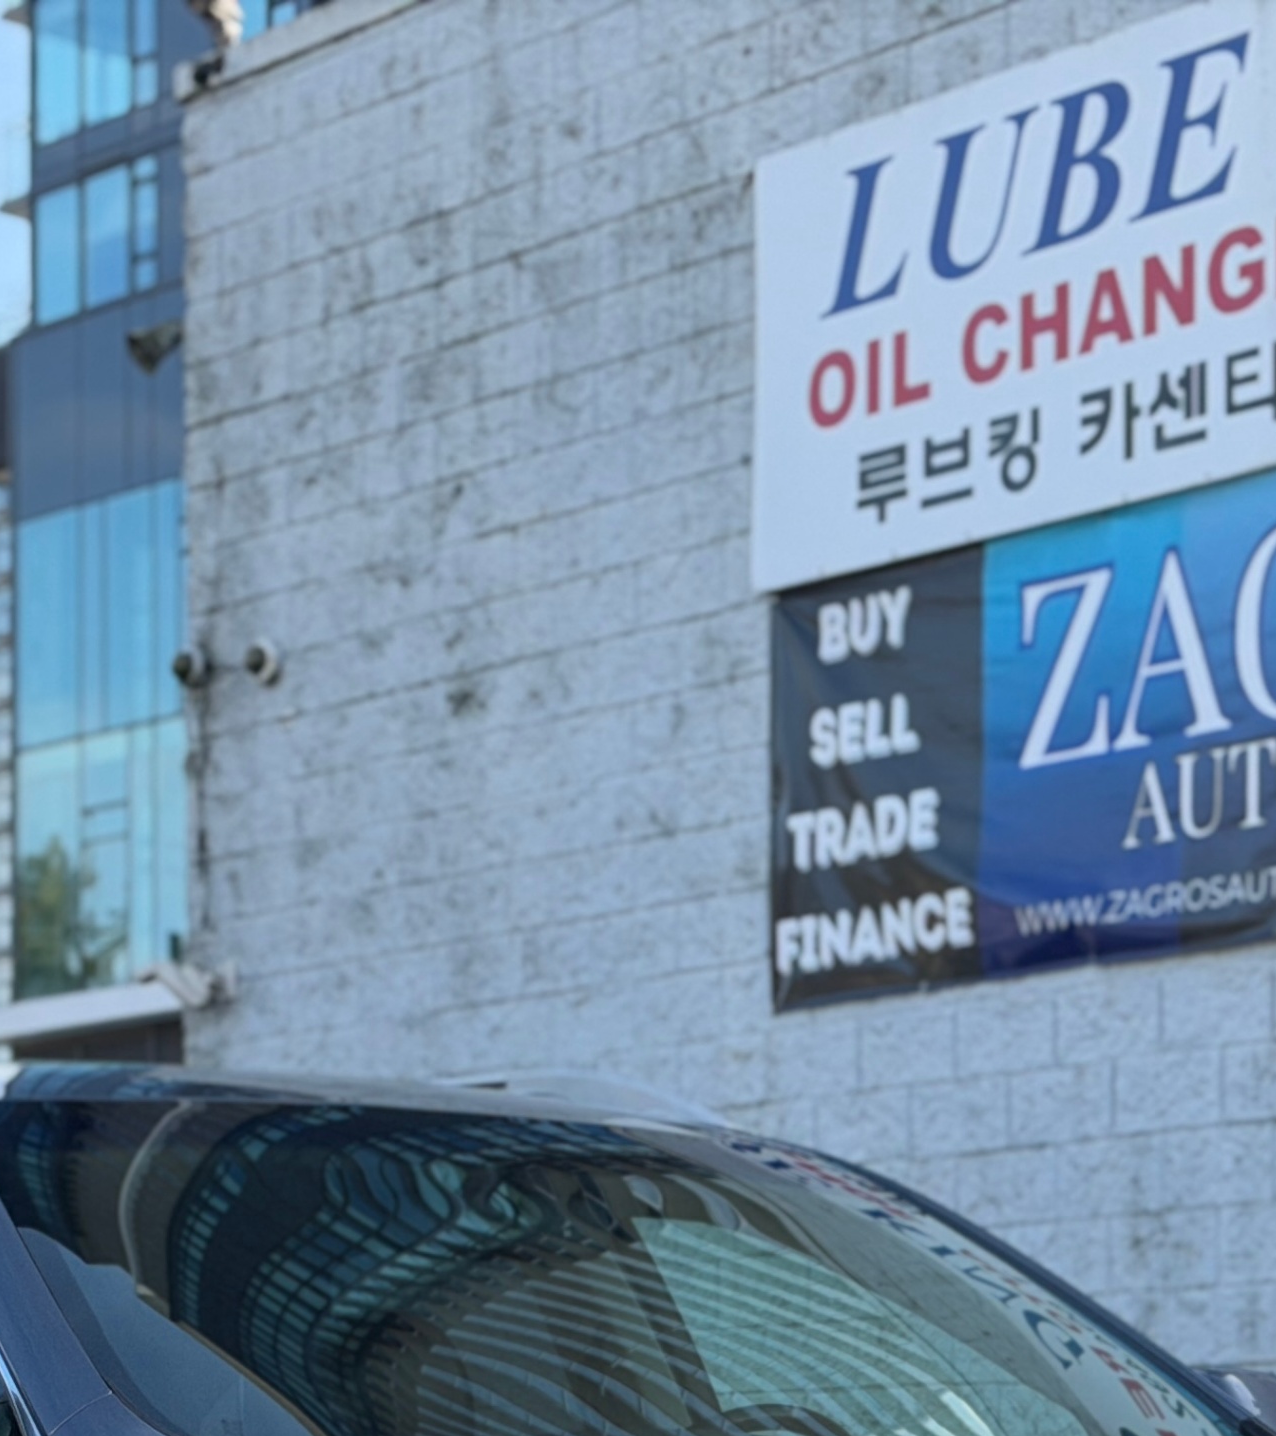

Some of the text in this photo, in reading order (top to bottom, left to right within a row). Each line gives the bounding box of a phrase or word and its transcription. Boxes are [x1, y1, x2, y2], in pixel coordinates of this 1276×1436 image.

[820, 30, 1252, 319] LUBE
[808, 331, 931, 429] OIL
[855, 407, 1042, 524] 루브킹
[818, 585, 911, 665] BUY
[808, 693, 920, 770] SELL
[787, 786, 941, 874] TRADE
[774, 886, 974, 977] FINANCE
